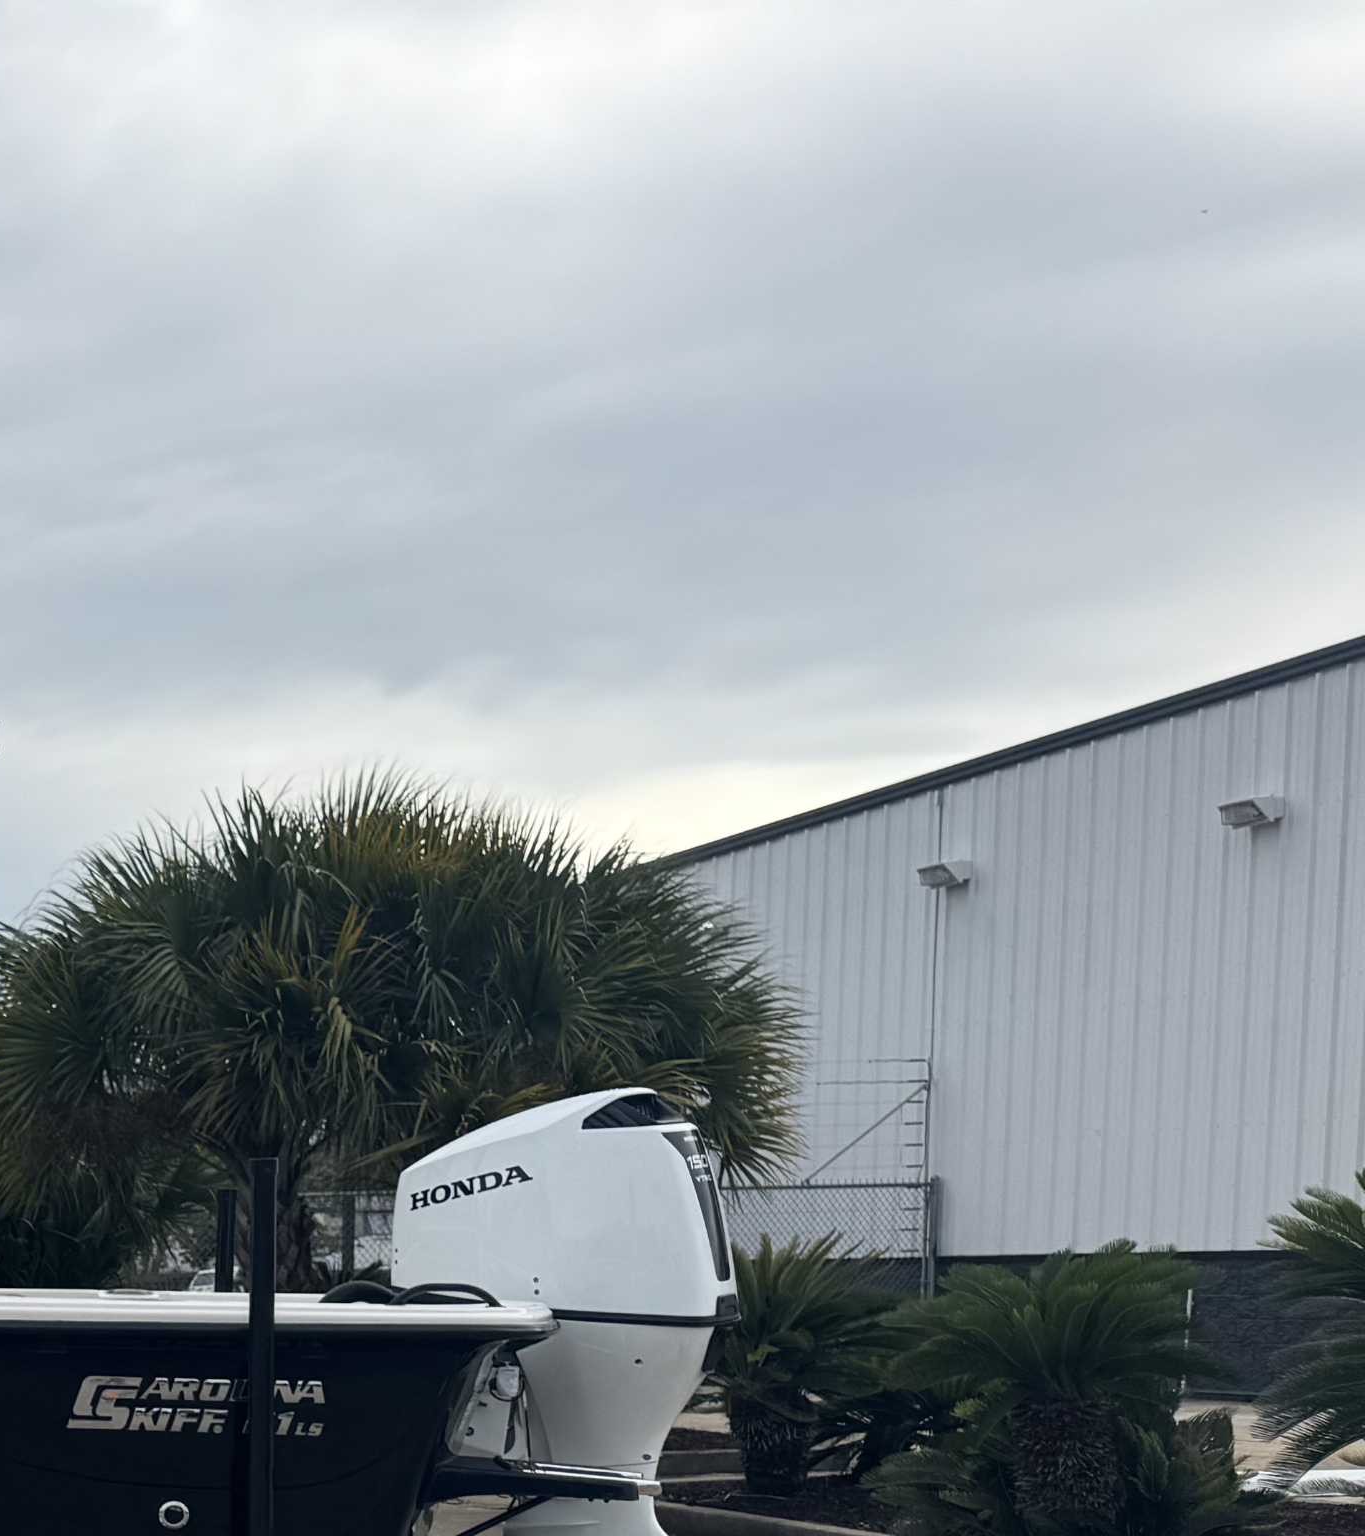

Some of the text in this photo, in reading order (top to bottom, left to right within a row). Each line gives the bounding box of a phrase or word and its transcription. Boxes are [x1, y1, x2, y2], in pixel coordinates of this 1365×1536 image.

[686, 1154, 709, 1170] 150
[410, 1165, 533, 1211] HONDA
[72, 1375, 325, 1417] CAROLNA
[294, 1422, 325, 1437] LS
